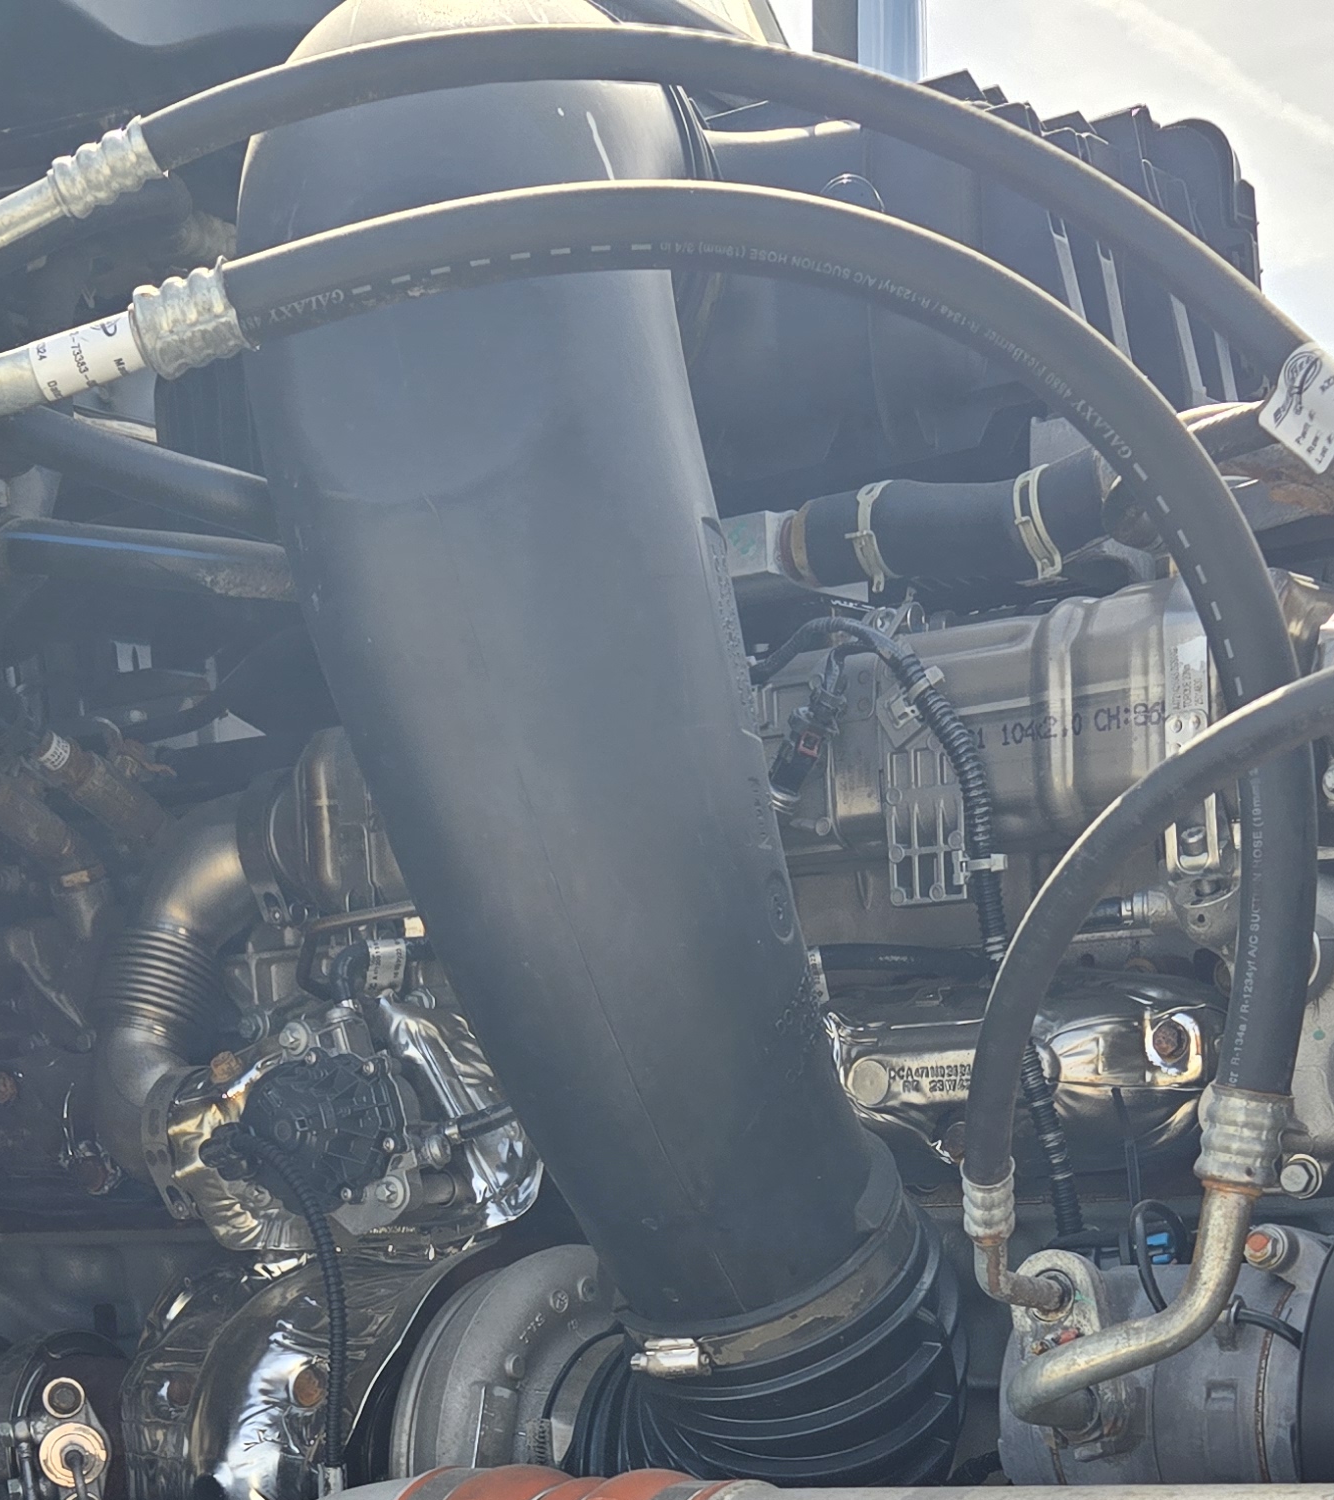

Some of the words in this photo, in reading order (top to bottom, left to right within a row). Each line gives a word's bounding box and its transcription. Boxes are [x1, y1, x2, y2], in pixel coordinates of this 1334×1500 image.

[749, 248, 787, 264] HOSE
[791, 255, 852, 280] SUCTION
[853, 271, 877, 288] A/C
[268, 288, 345, 323] GALAXY
[1071, 399, 1132, 459] GALAXY
[1252, 831, 1263, 869] HOSE
[1247, 934, 1259, 958] A/C
[1240, 959, 1258, 1014] R-1234yf
[1230, 1024, 1247, 1066] R-134a
